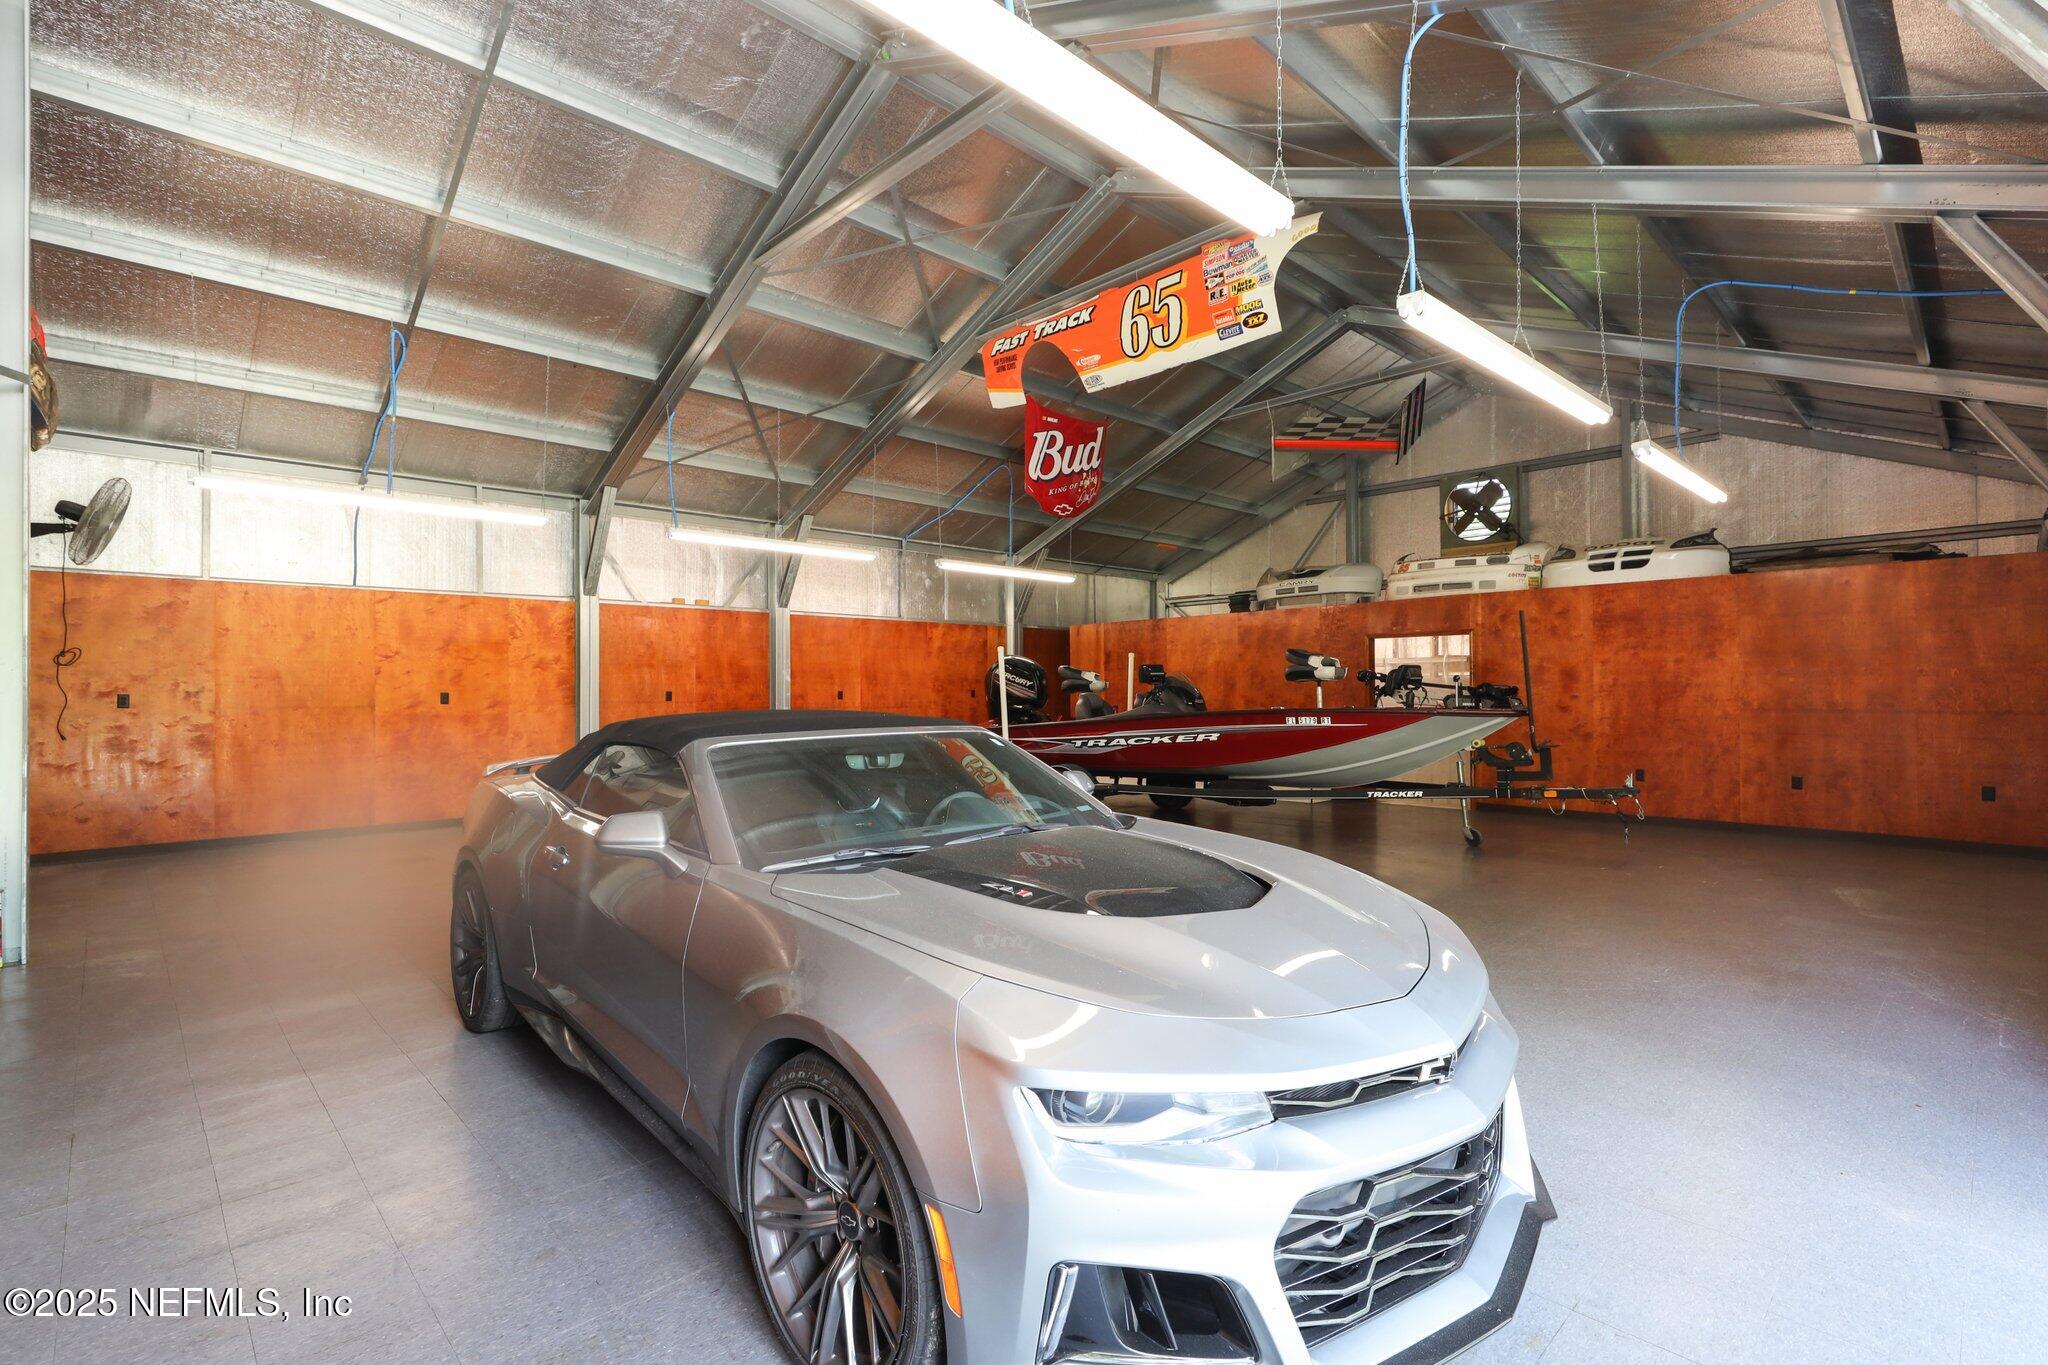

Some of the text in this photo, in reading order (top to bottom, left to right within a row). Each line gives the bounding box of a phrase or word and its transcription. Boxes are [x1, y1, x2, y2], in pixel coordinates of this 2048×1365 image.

[1203, 261, 1233, 276] Bowman
[1237, 278, 1253, 287] Auto
[1236, 300, 1262, 312] MOOG
[1120, 269, 1184, 358] 65
[991, 305, 1097, 357] FAST TRACK
[1028, 426, 1104, 481] Bud
[1048, 486, 1067, 496] KING
[1584, 539, 1665, 551] DODGE
[1279, 579, 1314, 587] CAMRY
[1071, 733, 1221, 748] TRACKER
